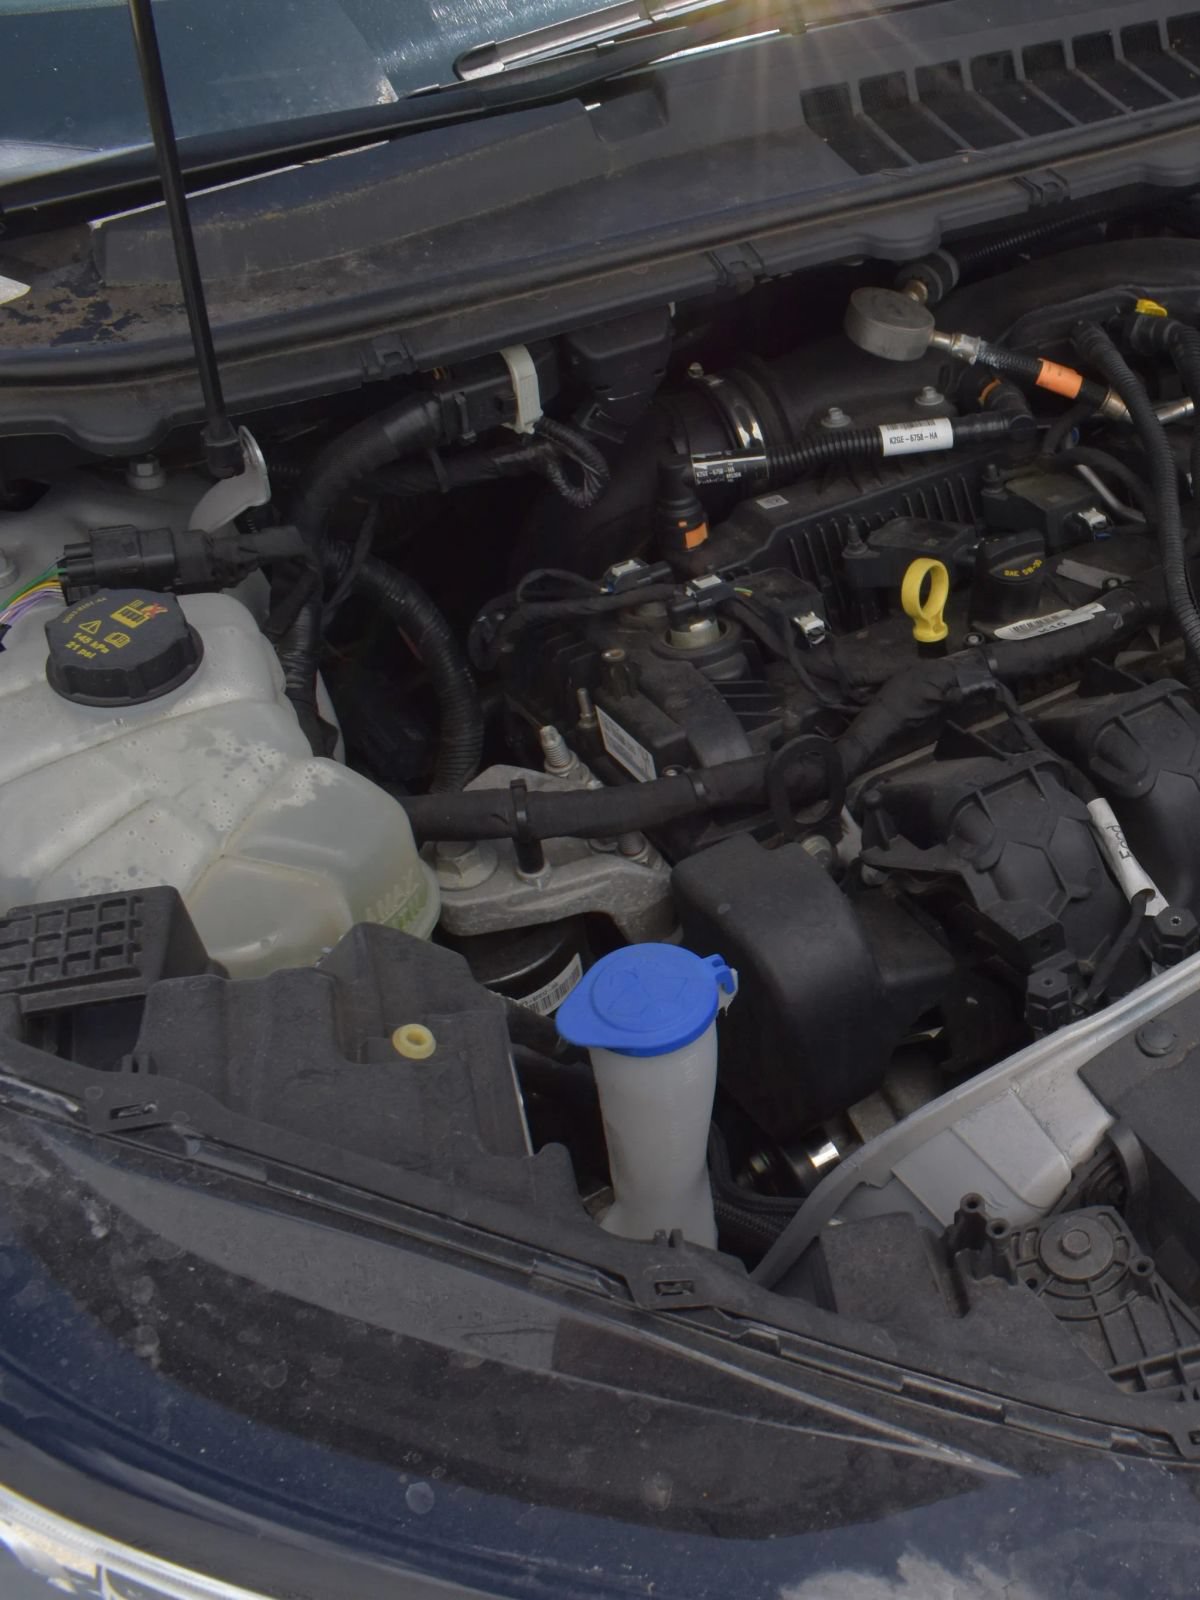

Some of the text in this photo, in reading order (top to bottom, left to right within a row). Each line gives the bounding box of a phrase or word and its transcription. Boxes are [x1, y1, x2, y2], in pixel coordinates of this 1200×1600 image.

[65, 641, 96, 658] 21 psi
[74, 633, 109, 653] 145 kPa
